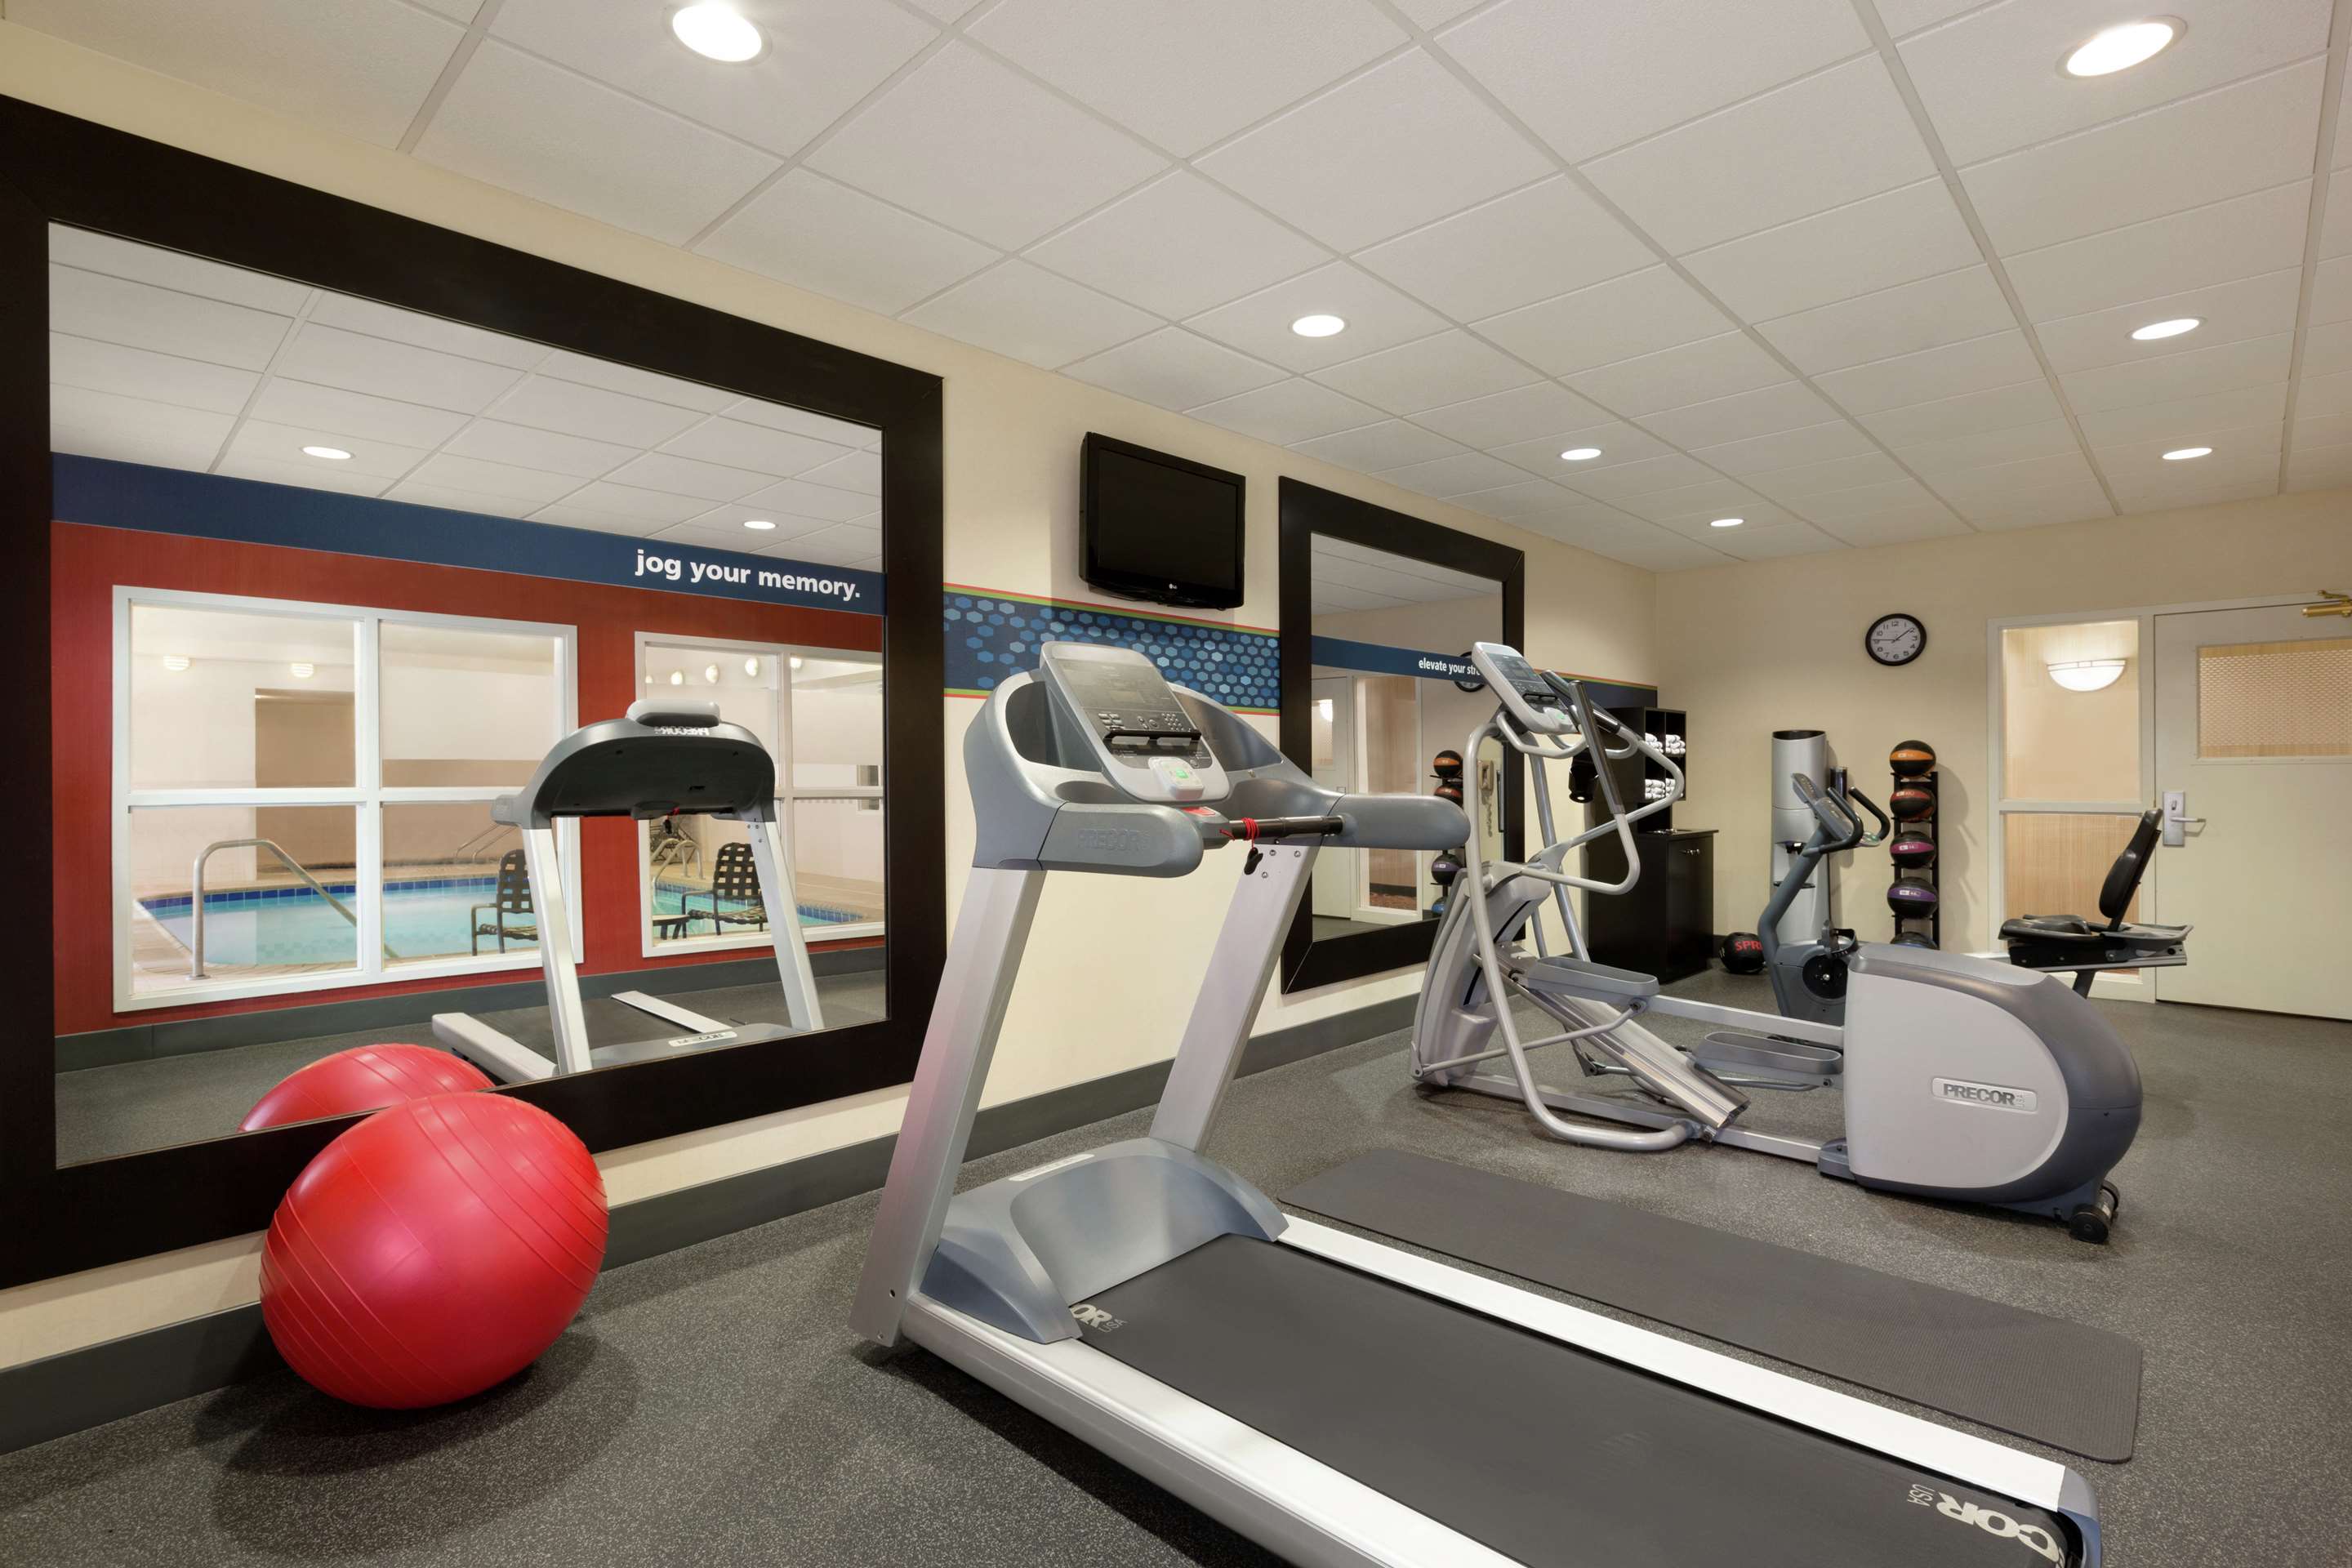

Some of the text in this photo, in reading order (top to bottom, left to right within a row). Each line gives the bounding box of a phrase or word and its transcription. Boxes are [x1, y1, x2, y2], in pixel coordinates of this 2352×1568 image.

[635, 549, 860, 601] jog your memory.
[1418, 657, 1447, 672] elevate
[1449, 663, 1466, 675] your
[1943, 1083, 2016, 1105] PRECOR
[1098, 1318, 1128, 1333] USA
[1906, 1483, 1936, 1508] USA
